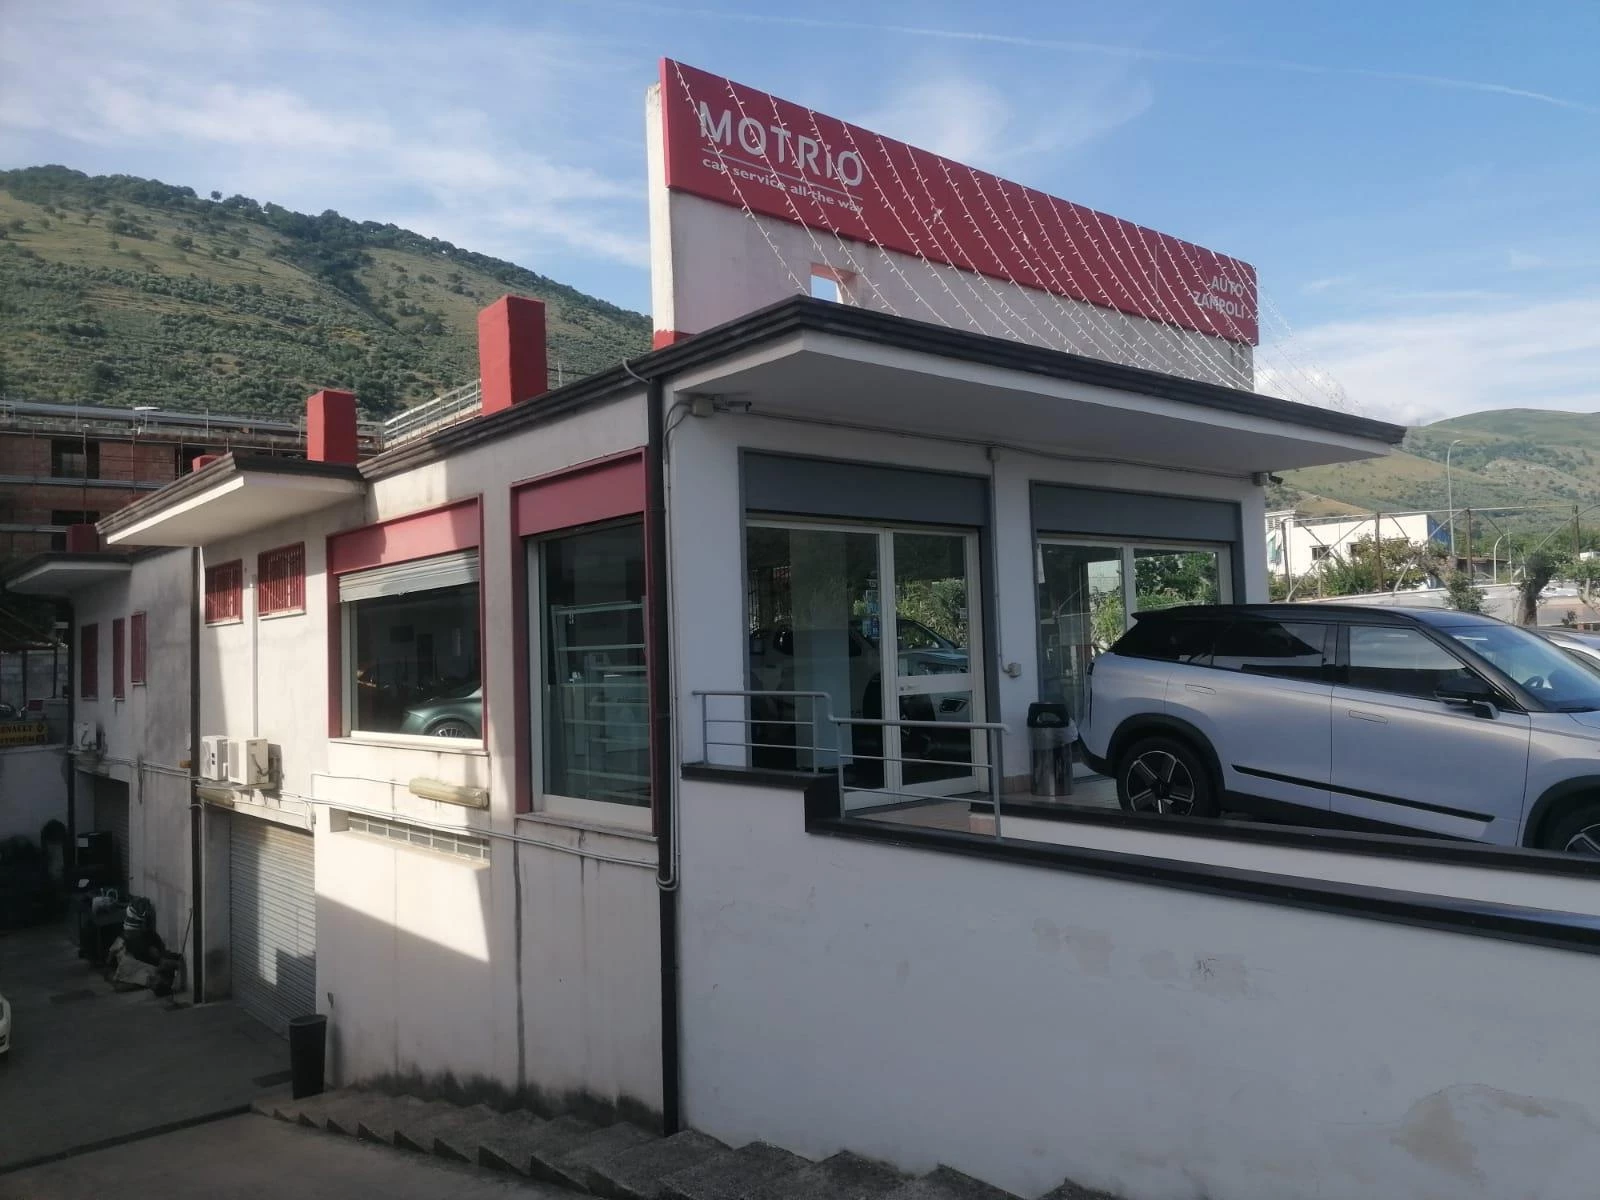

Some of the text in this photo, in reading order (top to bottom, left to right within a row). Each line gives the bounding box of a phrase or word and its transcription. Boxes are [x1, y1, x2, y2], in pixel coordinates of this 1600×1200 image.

[702, 158, 863, 215] car service all the way
[1211, 276, 1244, 298] AUTO
